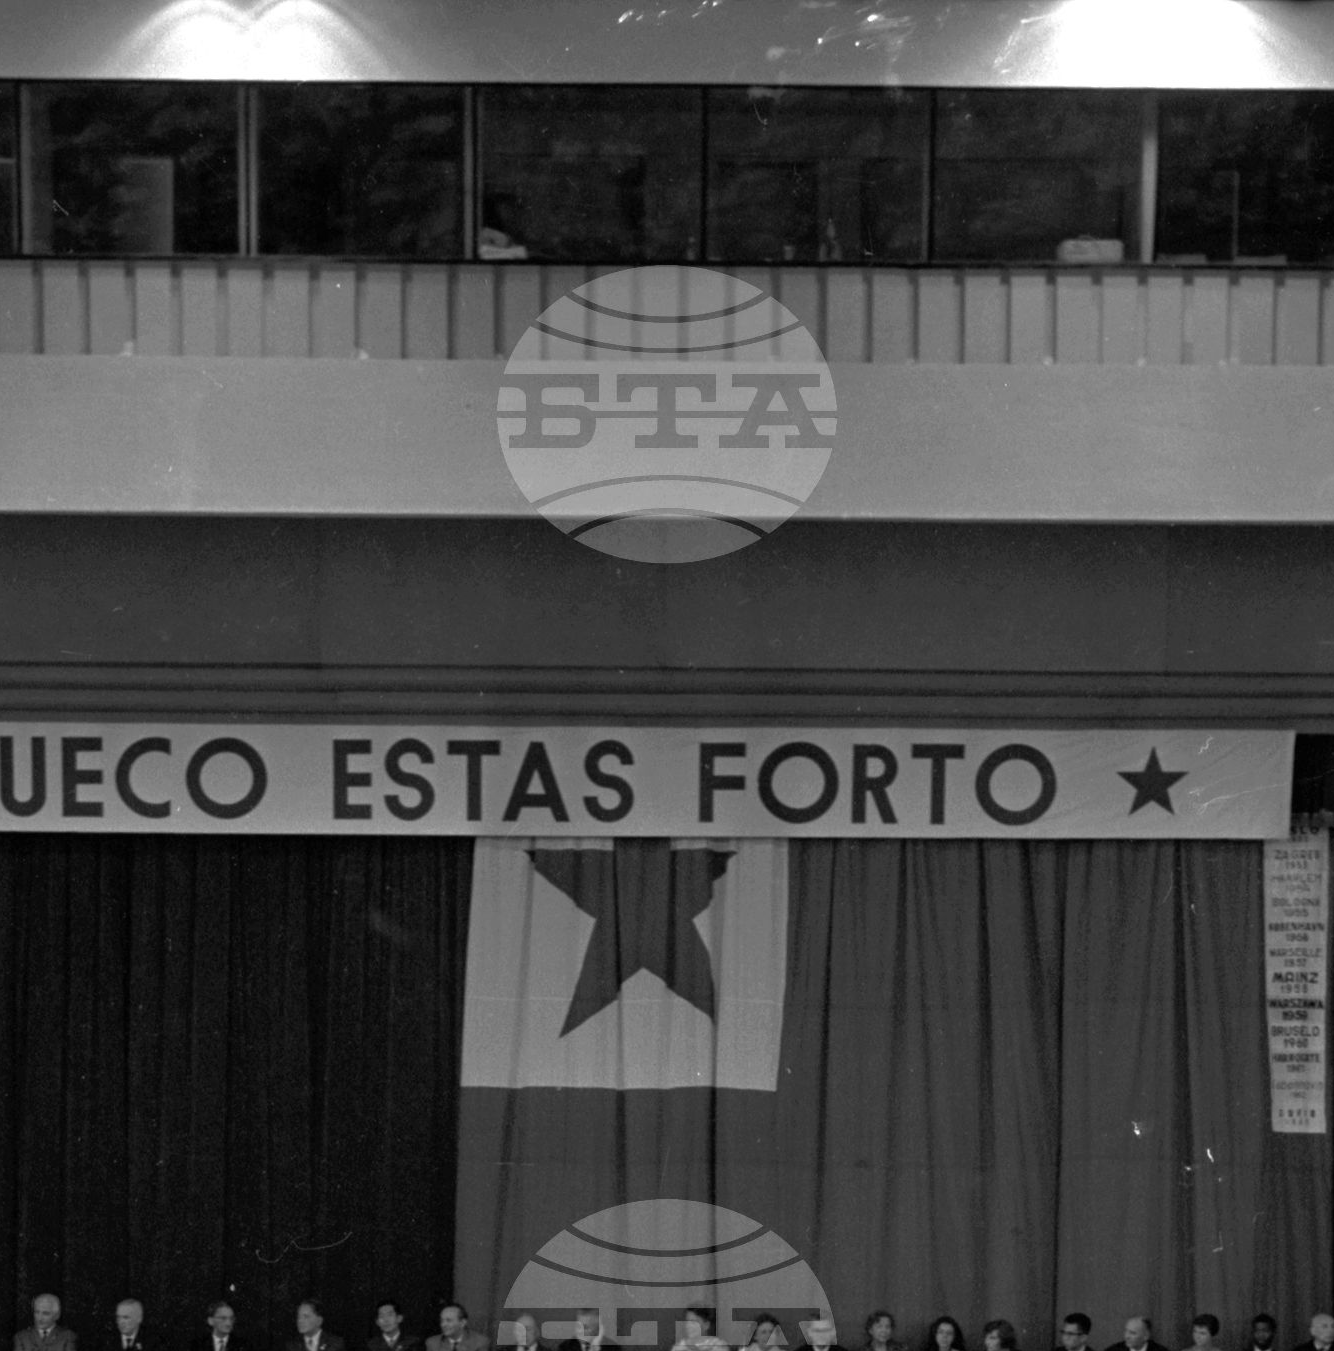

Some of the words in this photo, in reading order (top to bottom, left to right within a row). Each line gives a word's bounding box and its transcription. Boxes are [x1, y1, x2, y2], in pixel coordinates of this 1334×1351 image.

[332, 738, 635, 823] ESTAS
[698, 743, 1057, 825] FORTO
[1272, 972, 1319, 984] MAINZ
[1271, 1026, 1320, 1037] BRUSELO
